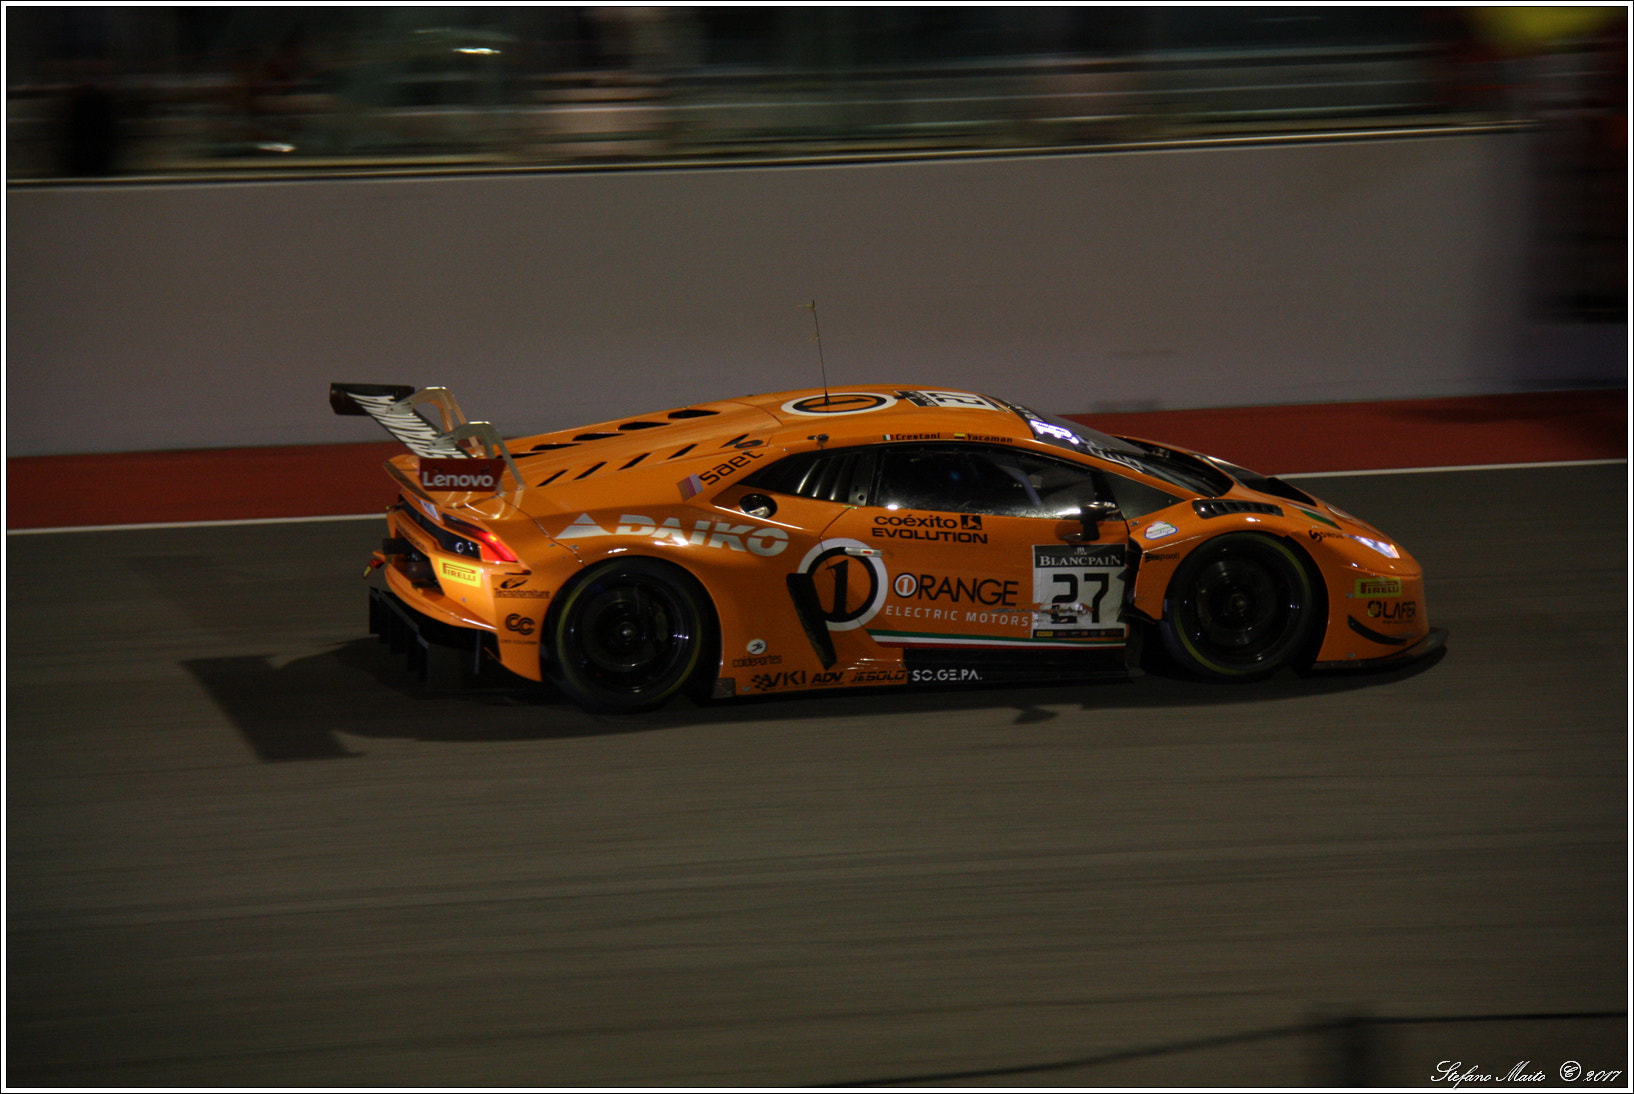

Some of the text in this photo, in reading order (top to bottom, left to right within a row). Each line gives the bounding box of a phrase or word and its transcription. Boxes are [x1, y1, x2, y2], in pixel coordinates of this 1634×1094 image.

[896, 433, 940, 441] Crestani
[967, 434, 1013, 443] Yacaman
[699, 450, 764, 485] saet
[422, 471, 494, 487] Lenovo
[874, 514, 957, 529] coéxito
[872, 528, 988, 544] EVOLUTION
[1039, 554, 1121, 567] BLANCPAIN
[442, 562, 476, 582] PIRELLI
[1360, 580, 1400, 594] PIRELLI
[1051, 572, 1110, 624] 27
[885, 605, 1030, 627] ELECTRIC MOTORS
